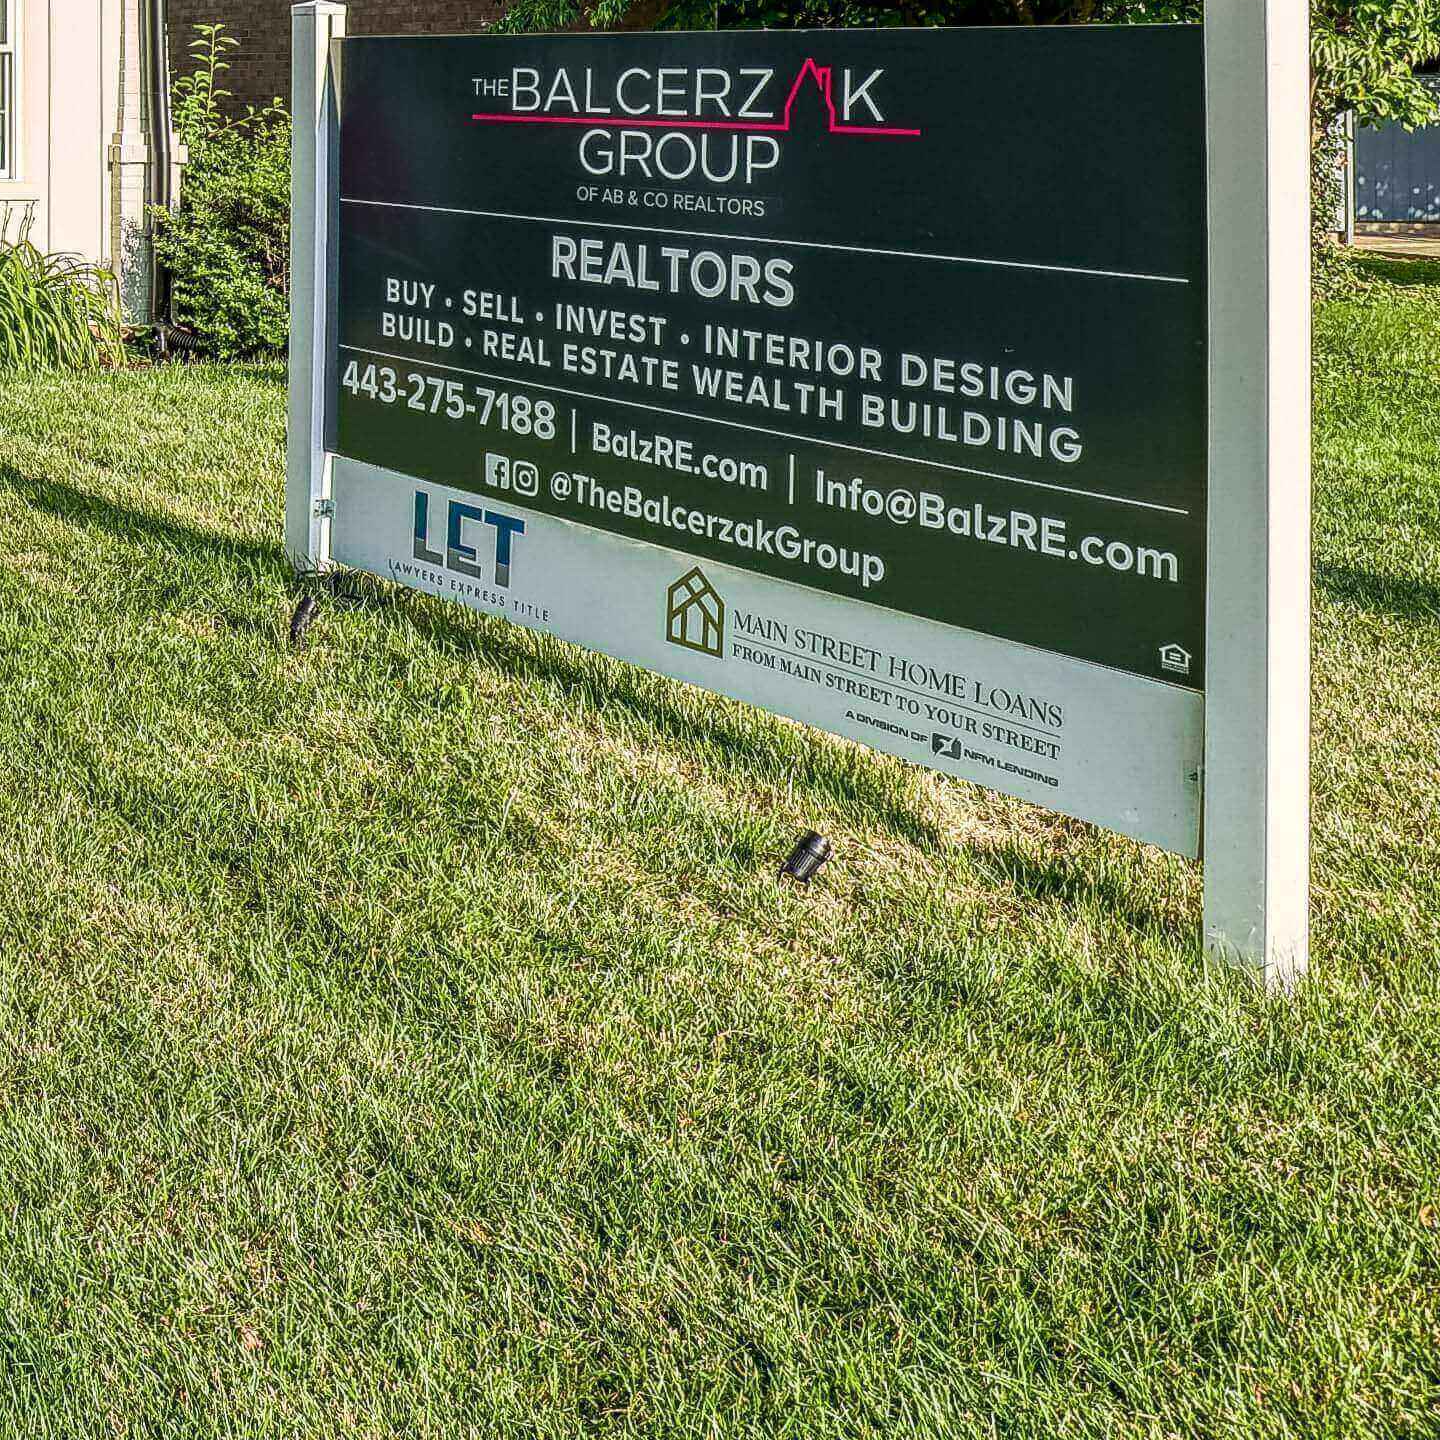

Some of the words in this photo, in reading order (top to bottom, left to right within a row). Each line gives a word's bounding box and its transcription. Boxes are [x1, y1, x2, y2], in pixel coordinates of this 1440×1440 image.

[472, 78, 509, 97] THE
[579, 129, 780, 184] GROUP
[576, 186, 598, 202] OF
[602, 189, 623, 205] AB
[628, 191, 639, 206] &
[643, 192, 668, 208] CO
[673, 194, 765, 216] REALTORS
[552, 235, 794, 307] REALTORS
[382, 312, 454, 348] BUILD
[483, 330, 551, 367] REAL
[563, 344, 679, 391] ESTATE
[692, 364, 843, 422] WEALTH
[861, 394, 1083, 463] BUILDING
[387, 278, 435, 309] BUY
[463, 289, 524, 324] SELL
[555, 303, 667, 346] INVEST
[704, 324, 882, 383] INTERIOR
[901, 353, 1073, 412] DESIGN
[342, 361, 556, 440] 443-275-7188
[592, 422, 768, 490] BalzRE.com
[816, 470, 1178, 583] Info@BalzRE.com
[413, 490, 526, 588] LET
[550, 471, 885, 588] @TheBalcerzakGroup
[388, 559, 444, 586] LAWYERS
[450, 579, 505, 607] EXPRESS
[513, 600, 550, 622] TITLE
[732, 643, 776, 669] FROM
[780, 661, 822, 684] MAIN
[825, 673, 893, 707] STREET
[895, 694, 919, 715] TO
[925, 703, 978, 735] YOUR
[982, 722, 1061, 761] STREET
[733, 610, 788, 645] MAIN
[794, 630, 882, 673] STREET
[889, 656, 966, 700] HOME
[974, 681, 1063, 729] LOANS
[845, 710, 855, 720] A
[856, 715, 909, 738] DIVISION
[910, 731, 928, 743] OF
[963, 748, 996, 766] NFM
[997, 760, 1059, 787] LENDING
